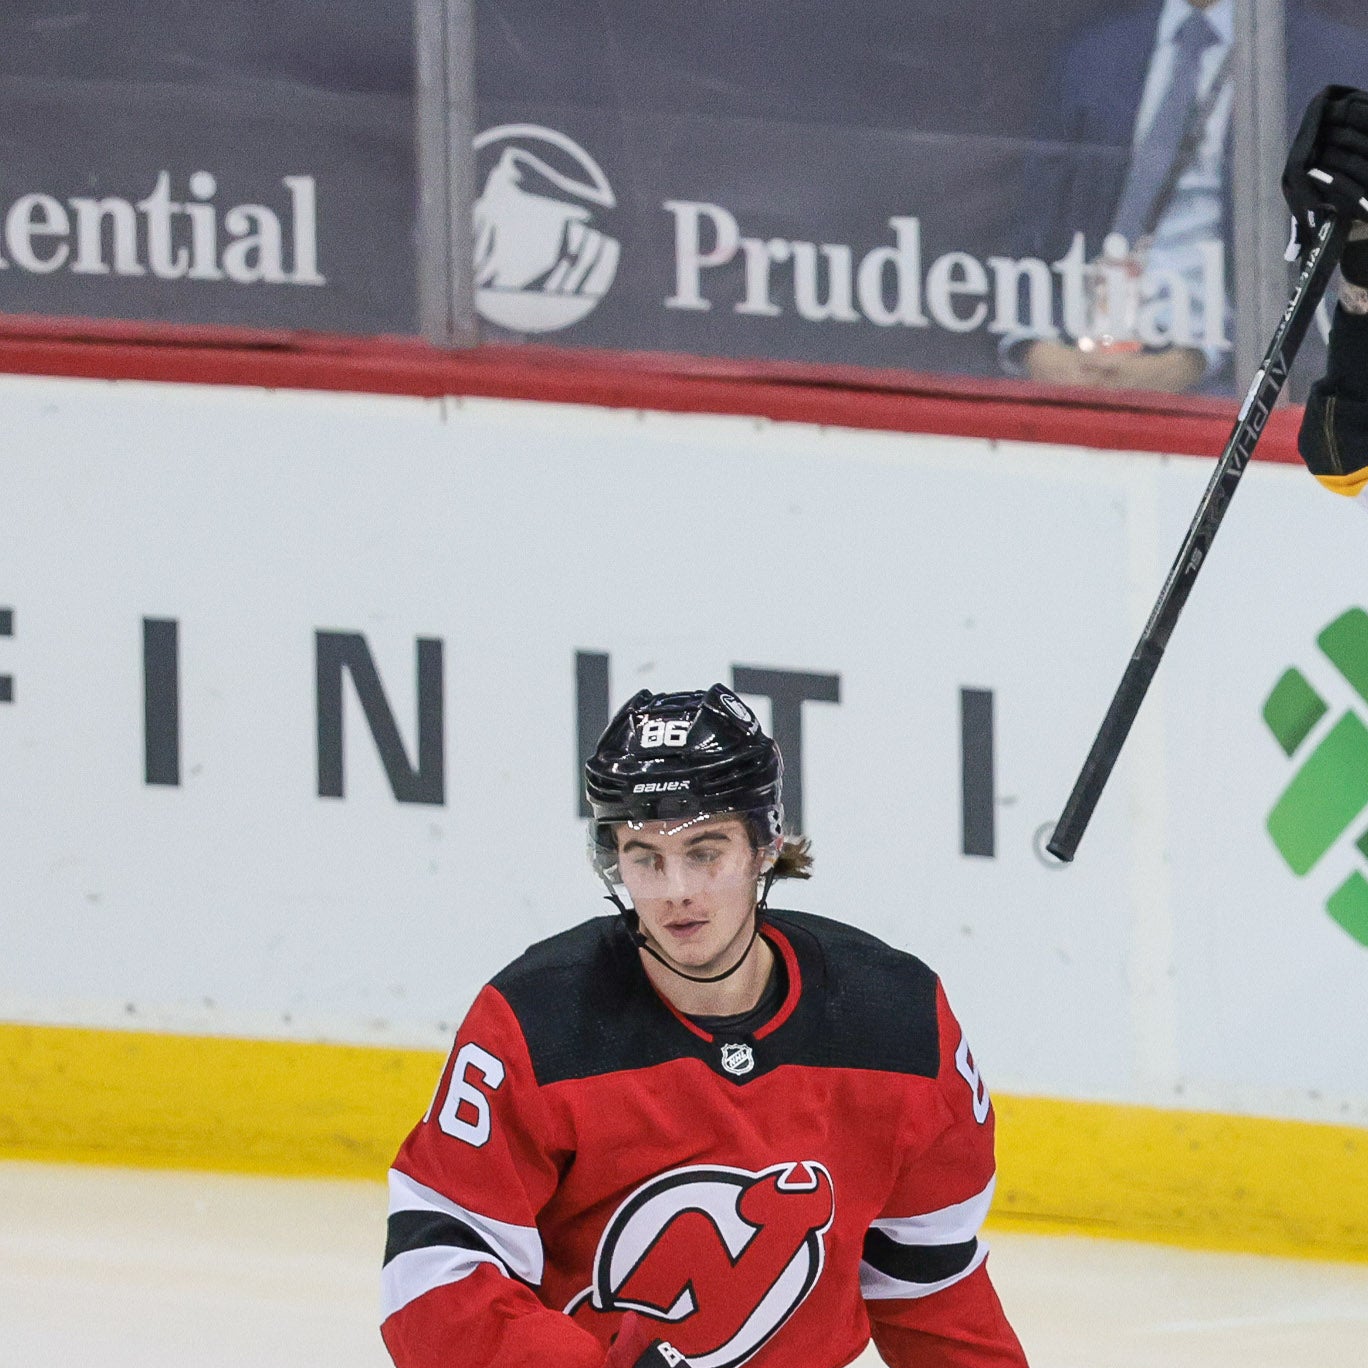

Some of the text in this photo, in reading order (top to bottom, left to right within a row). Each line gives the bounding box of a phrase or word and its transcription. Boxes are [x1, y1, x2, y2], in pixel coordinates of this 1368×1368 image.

[0, 169, 326, 286] ential
[663, 200, 1233, 352] Prudential
[640, 720, 690, 749] 86
[423, 1041, 506, 1149] 6
